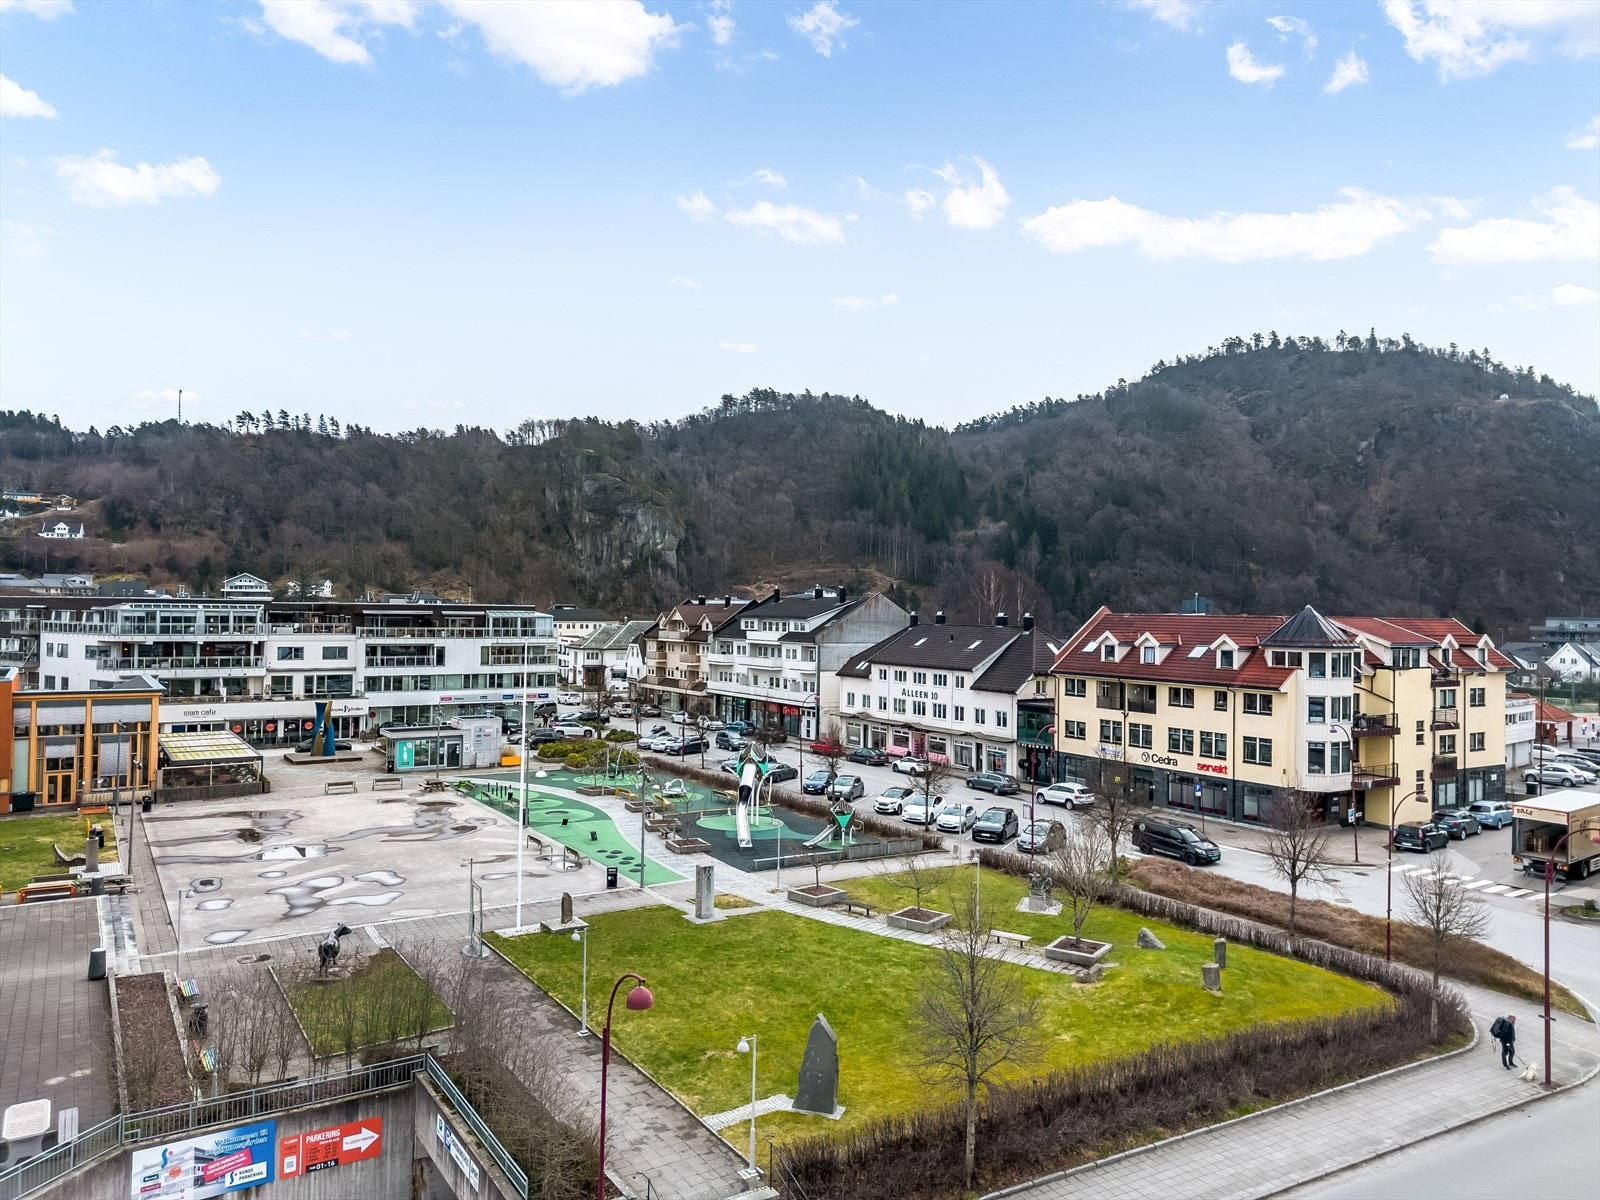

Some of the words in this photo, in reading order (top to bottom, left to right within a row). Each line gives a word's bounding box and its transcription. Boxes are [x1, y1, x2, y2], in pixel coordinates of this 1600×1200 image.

[901, 688, 928, 699] ALLEEN
[931, 692, 939, 700] 10
[200, 708, 216, 716] cafe
[1151, 753, 1178, 767] Cedra
[1516, 808, 1534, 816] PALS
[306, 1129, 341, 1144] PARKERING
[316, 1160, 335, 1170] 01-16
[239, 1168, 254, 1176] KUNDE
[239, 1171, 263, 1180] PARKERING
